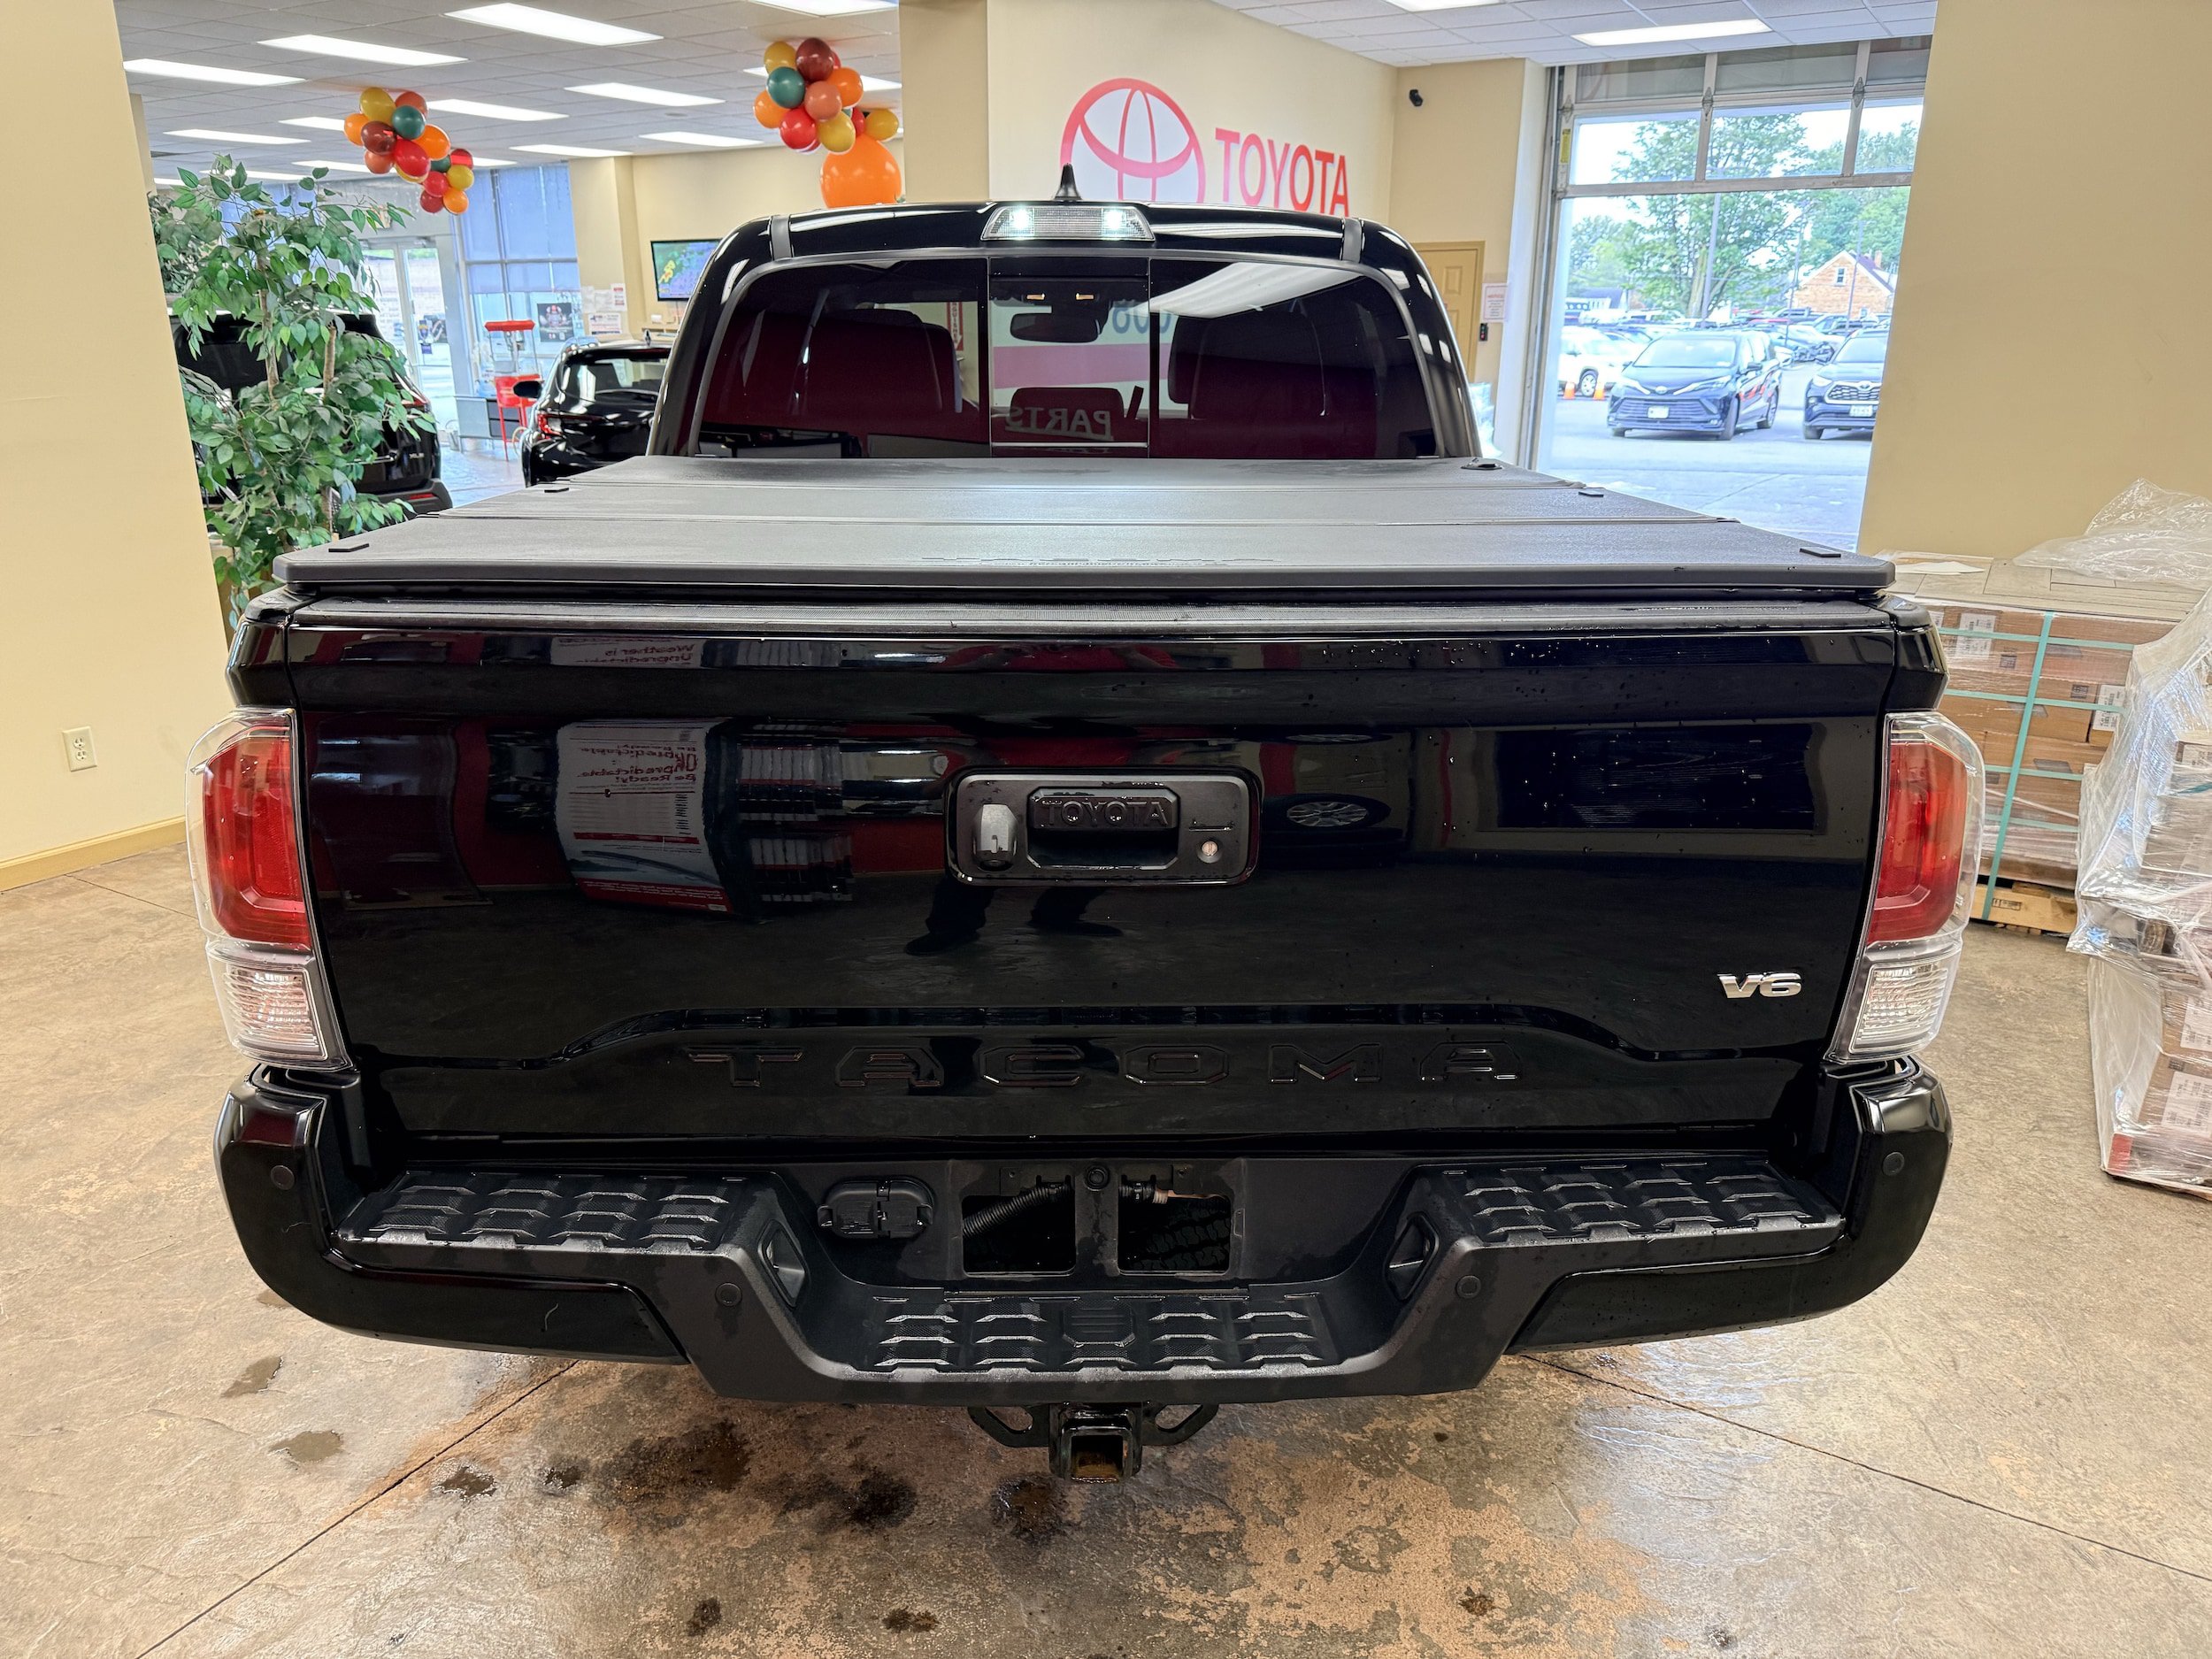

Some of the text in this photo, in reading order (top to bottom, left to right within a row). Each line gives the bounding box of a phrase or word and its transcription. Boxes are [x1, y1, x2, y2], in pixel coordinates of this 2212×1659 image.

[1215, 127, 1349, 218] TOYOTA
[1042, 801, 1168, 827] TOYOTA
[1717, 972, 1802, 999] V6
[687, 1041, 1521, 1087] TACOMA
